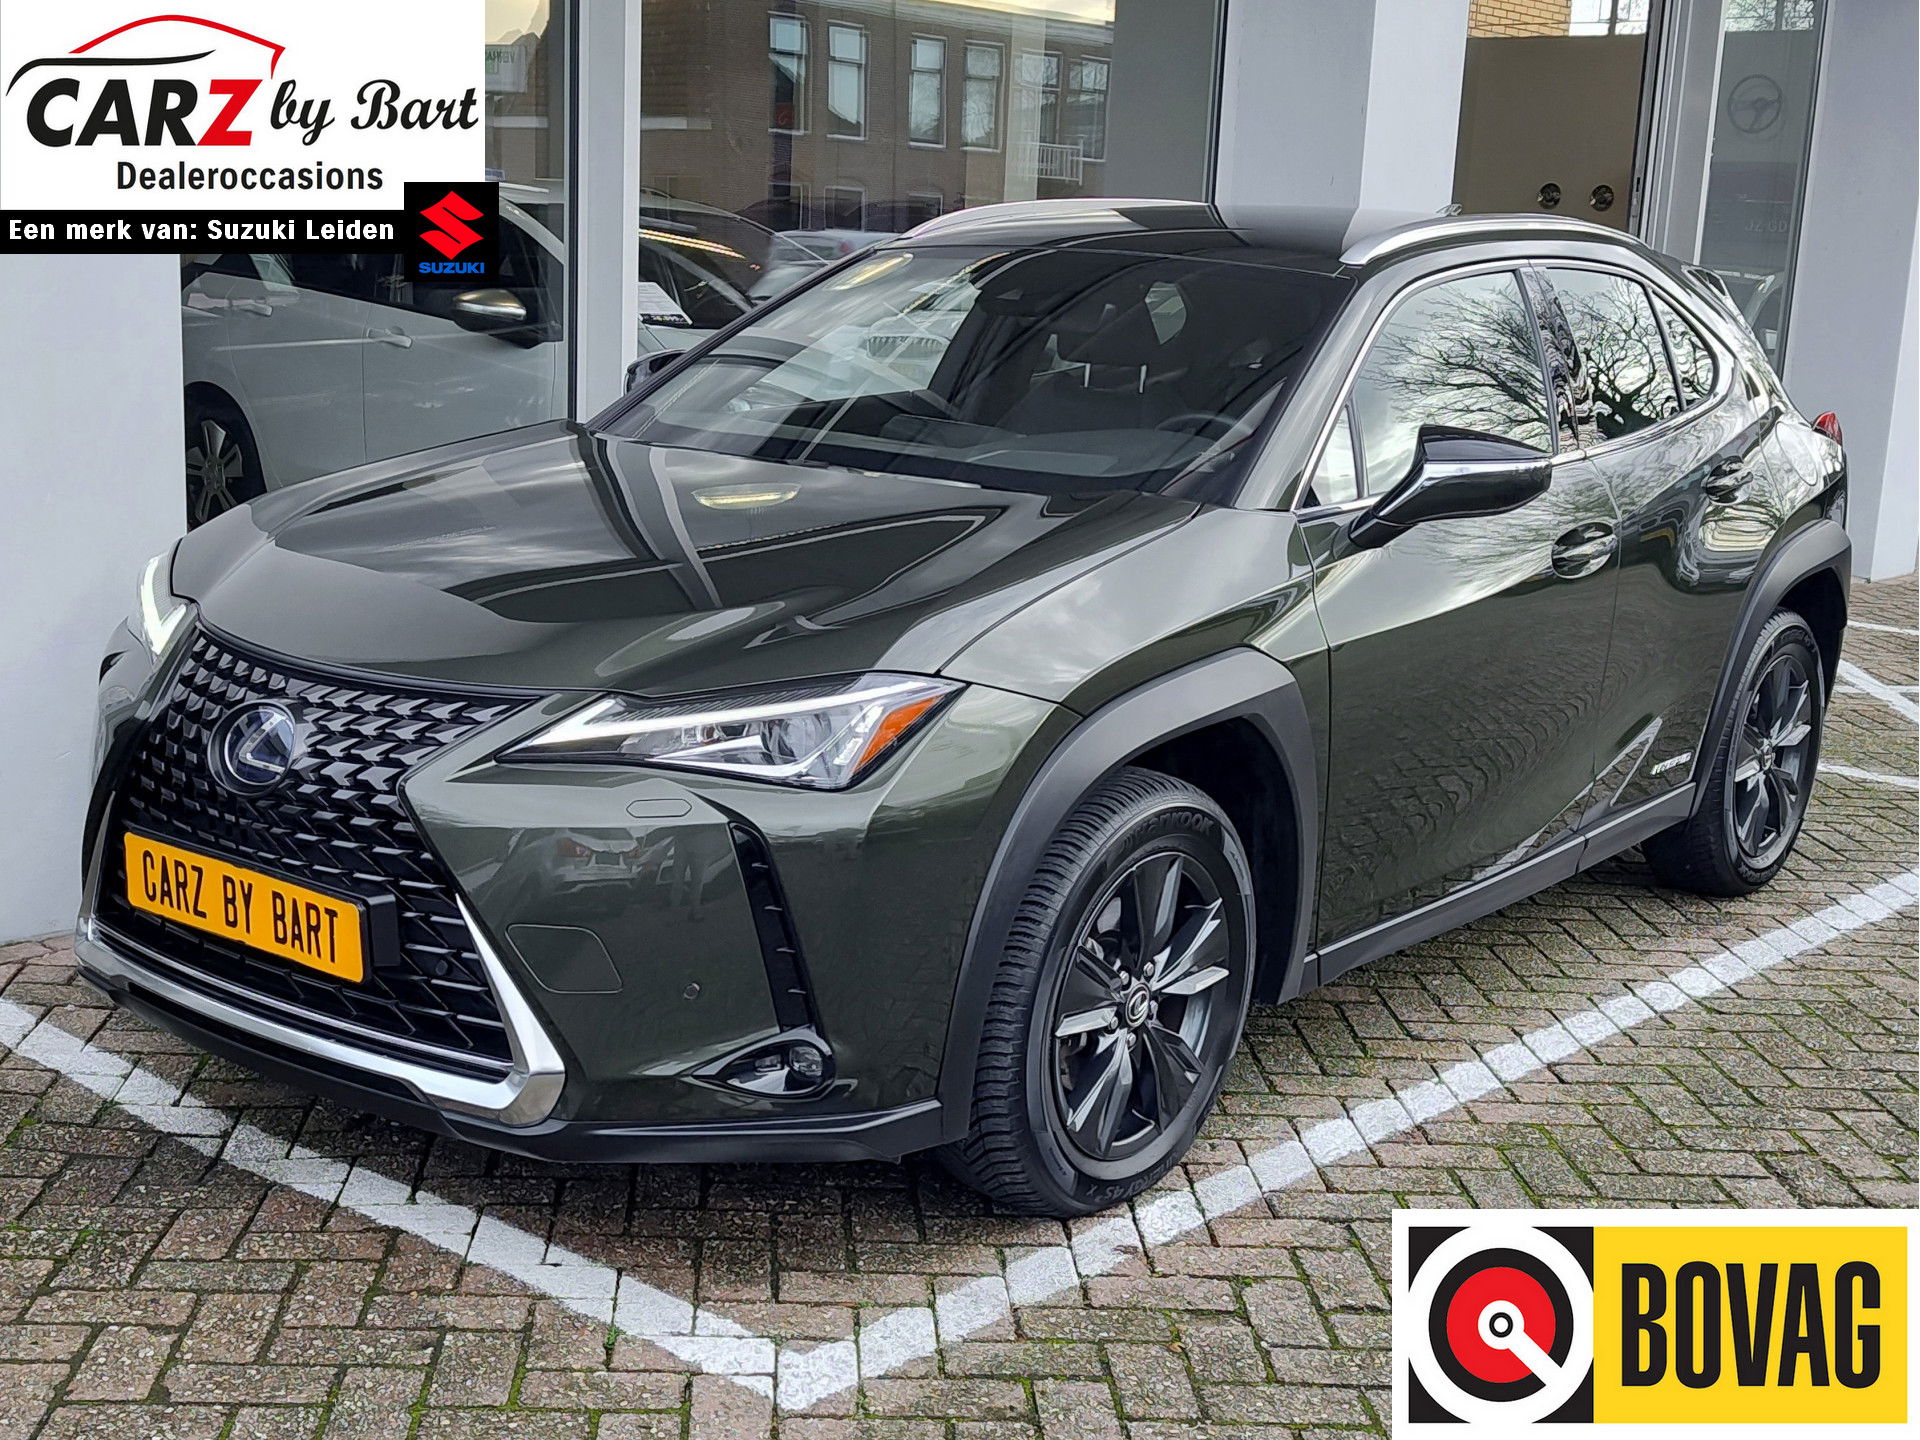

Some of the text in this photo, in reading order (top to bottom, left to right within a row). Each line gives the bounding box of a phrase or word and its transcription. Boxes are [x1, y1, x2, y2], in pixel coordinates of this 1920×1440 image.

[142, 850, 339, 964] CARZ BY BART
